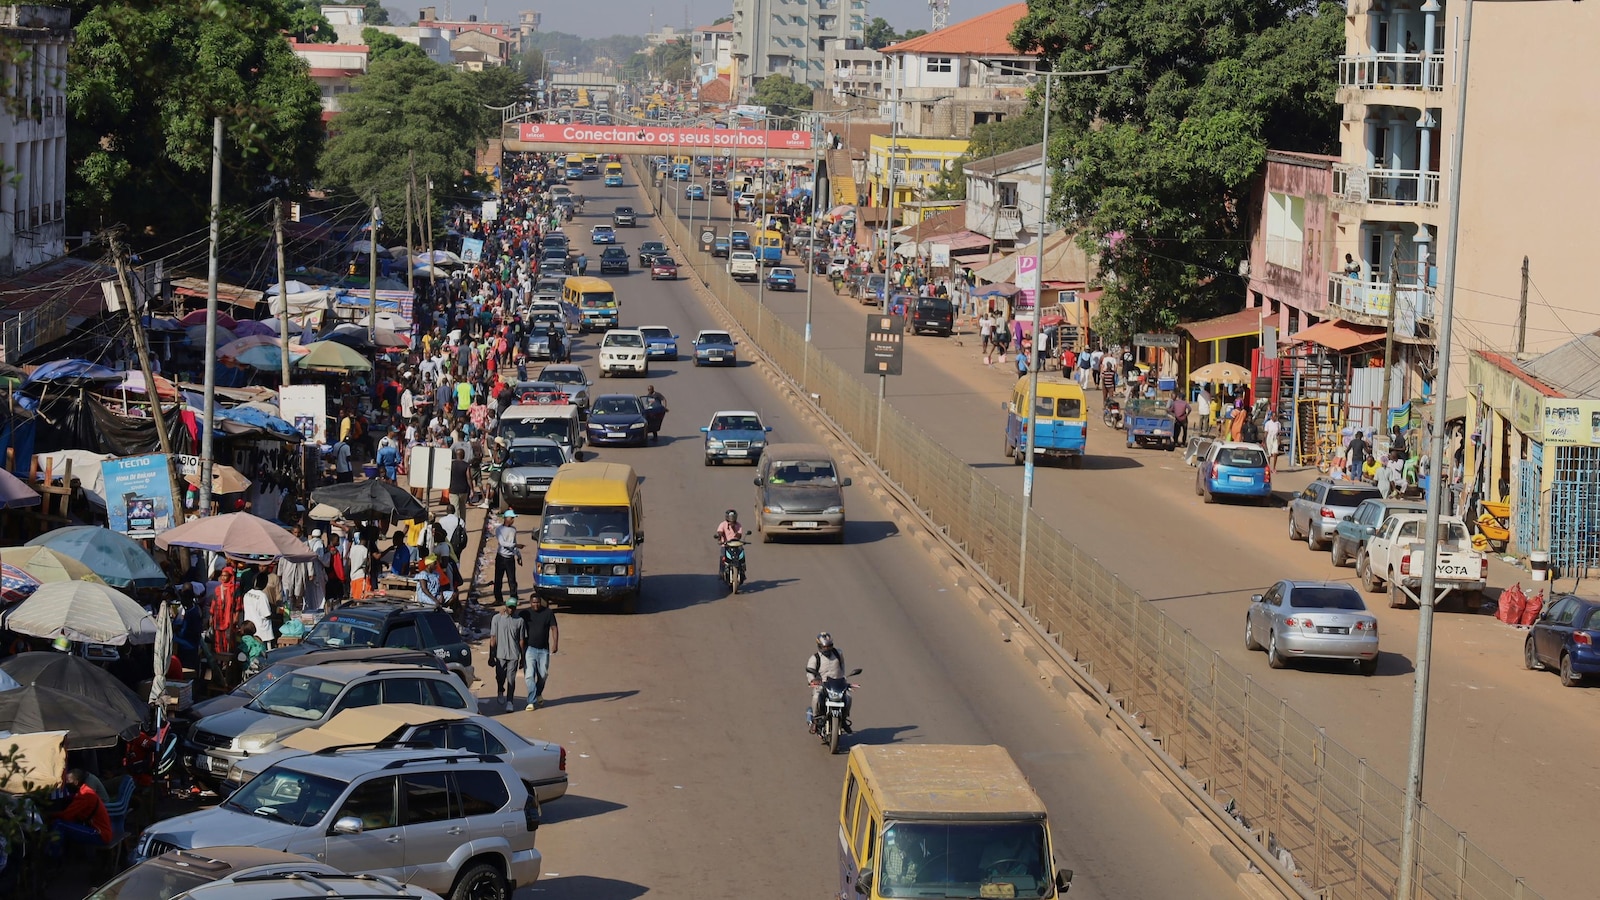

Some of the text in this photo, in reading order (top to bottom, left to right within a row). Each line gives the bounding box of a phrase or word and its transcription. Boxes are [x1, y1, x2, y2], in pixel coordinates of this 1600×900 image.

[563, 127, 767, 145] Conectando os seus sonhos.
[118, 457, 150, 469] TECNO
[1437, 565, 1468, 575] YOTA
